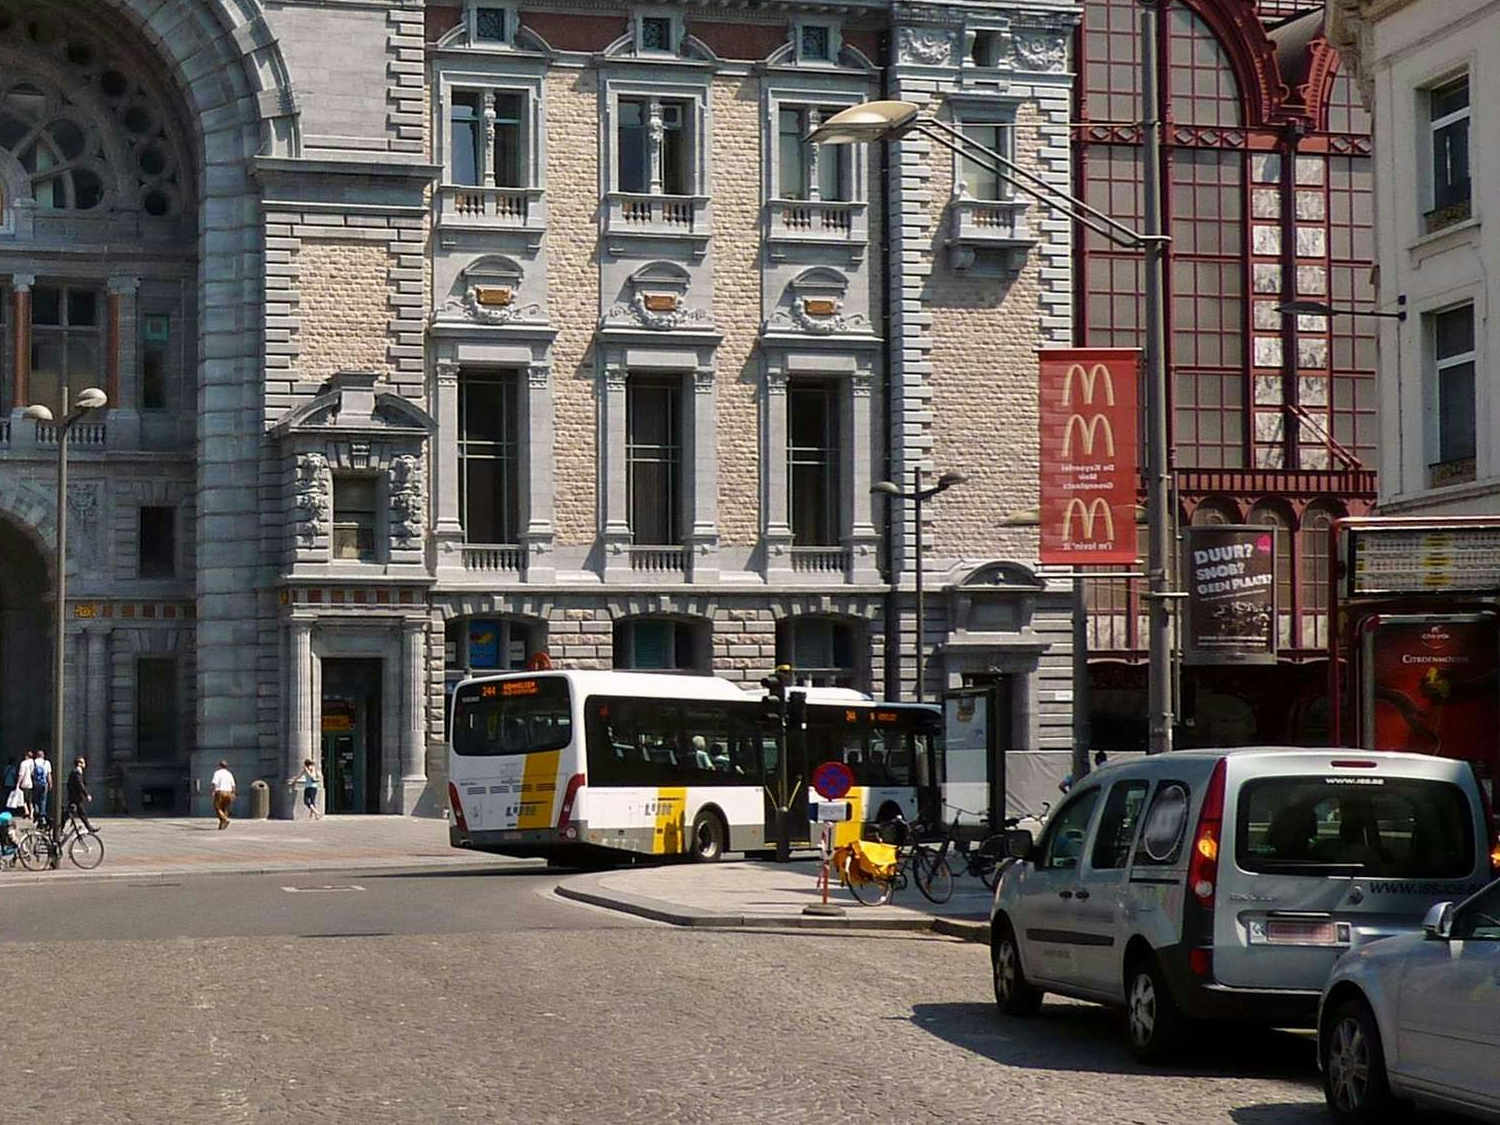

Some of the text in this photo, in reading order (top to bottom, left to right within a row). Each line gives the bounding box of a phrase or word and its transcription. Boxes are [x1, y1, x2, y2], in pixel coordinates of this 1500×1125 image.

[1194, 543, 1254, 565] DUUR?
[1195, 562, 1245, 580] SNOB?
[1197, 580, 1230, 594] GEEN
